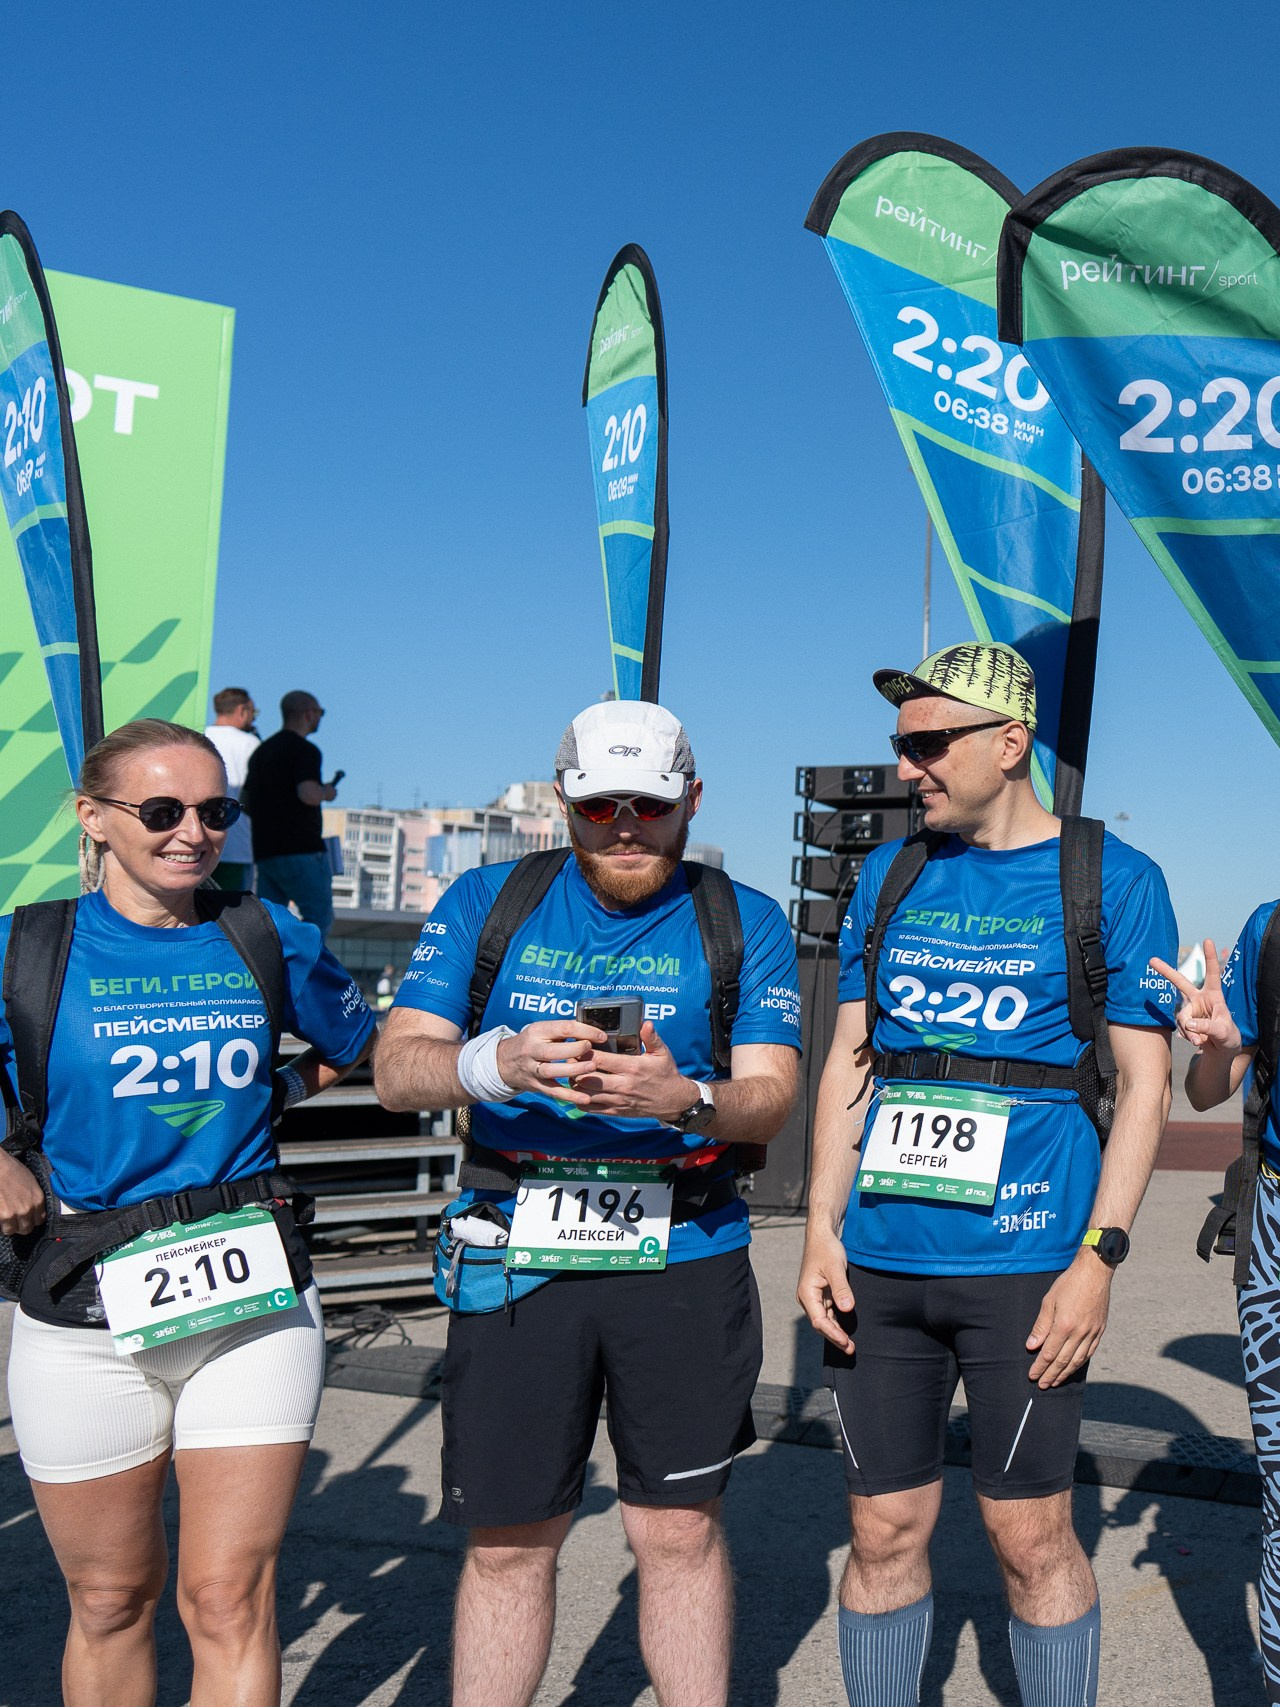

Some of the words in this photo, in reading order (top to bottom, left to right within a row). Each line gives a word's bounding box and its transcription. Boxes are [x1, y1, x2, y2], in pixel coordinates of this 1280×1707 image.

[893, 306, 1050, 412] 2:20
[4, 376, 46, 469] 2:10
[934, 390, 1009, 435] 06:38
[602, 403, 646, 473] 2:10
[1013, 430, 1034, 444] км
[1014, 419, 1045, 437] мин
[607, 476, 628, 502] 06:09
[1182, 464, 1272, 494] 06:38
[902, 909, 962, 934] БЕГИ,
[964, 914, 1045, 936] ГЕРОЙ!
[905, 935, 984, 951] БЛАГОТВОРИТЕЛЬНЫЙ
[985, 943, 1038, 951] ПОЛУМАРАФОН
[520, 944, 584, 974] БЕГИ,
[589, 953, 680, 977] ГЕРОЙ!
[888, 947, 1035, 976] ПЕЙСМЕЙКЕР
[90, 976, 167, 996] БЕГИ,
[524, 975, 614, 991] БЛАГОТВОРИТЕЛЬНЫЙ
[615, 985, 678, 993] ПОЛУМАРАФОН
[104, 999, 206, 1012] БЛАГОТВОРИТЕЛЬНЫЙ
[889, 975, 1029, 1031] 2:20
[93, 1011, 265, 1038] ПЕЙСМЕЙКЕР
[110, 1038, 259, 1098] 2:10
[891, 1111, 978, 1152] 1198
[899, 1153, 947, 1169] СЕРГЕЙ
[1021, 1181, 1050, 1196] ПСБ
[548, 1187, 644, 1223] 1196
[557, 1227, 625, 1241] АЛЕКСЕЙ
[155, 1237, 227, 1263] ПЕЙСМЕЙКЕР
[144, 1248, 250, 1308] 2:10
[197, 1295, 212, 1304] 1195
